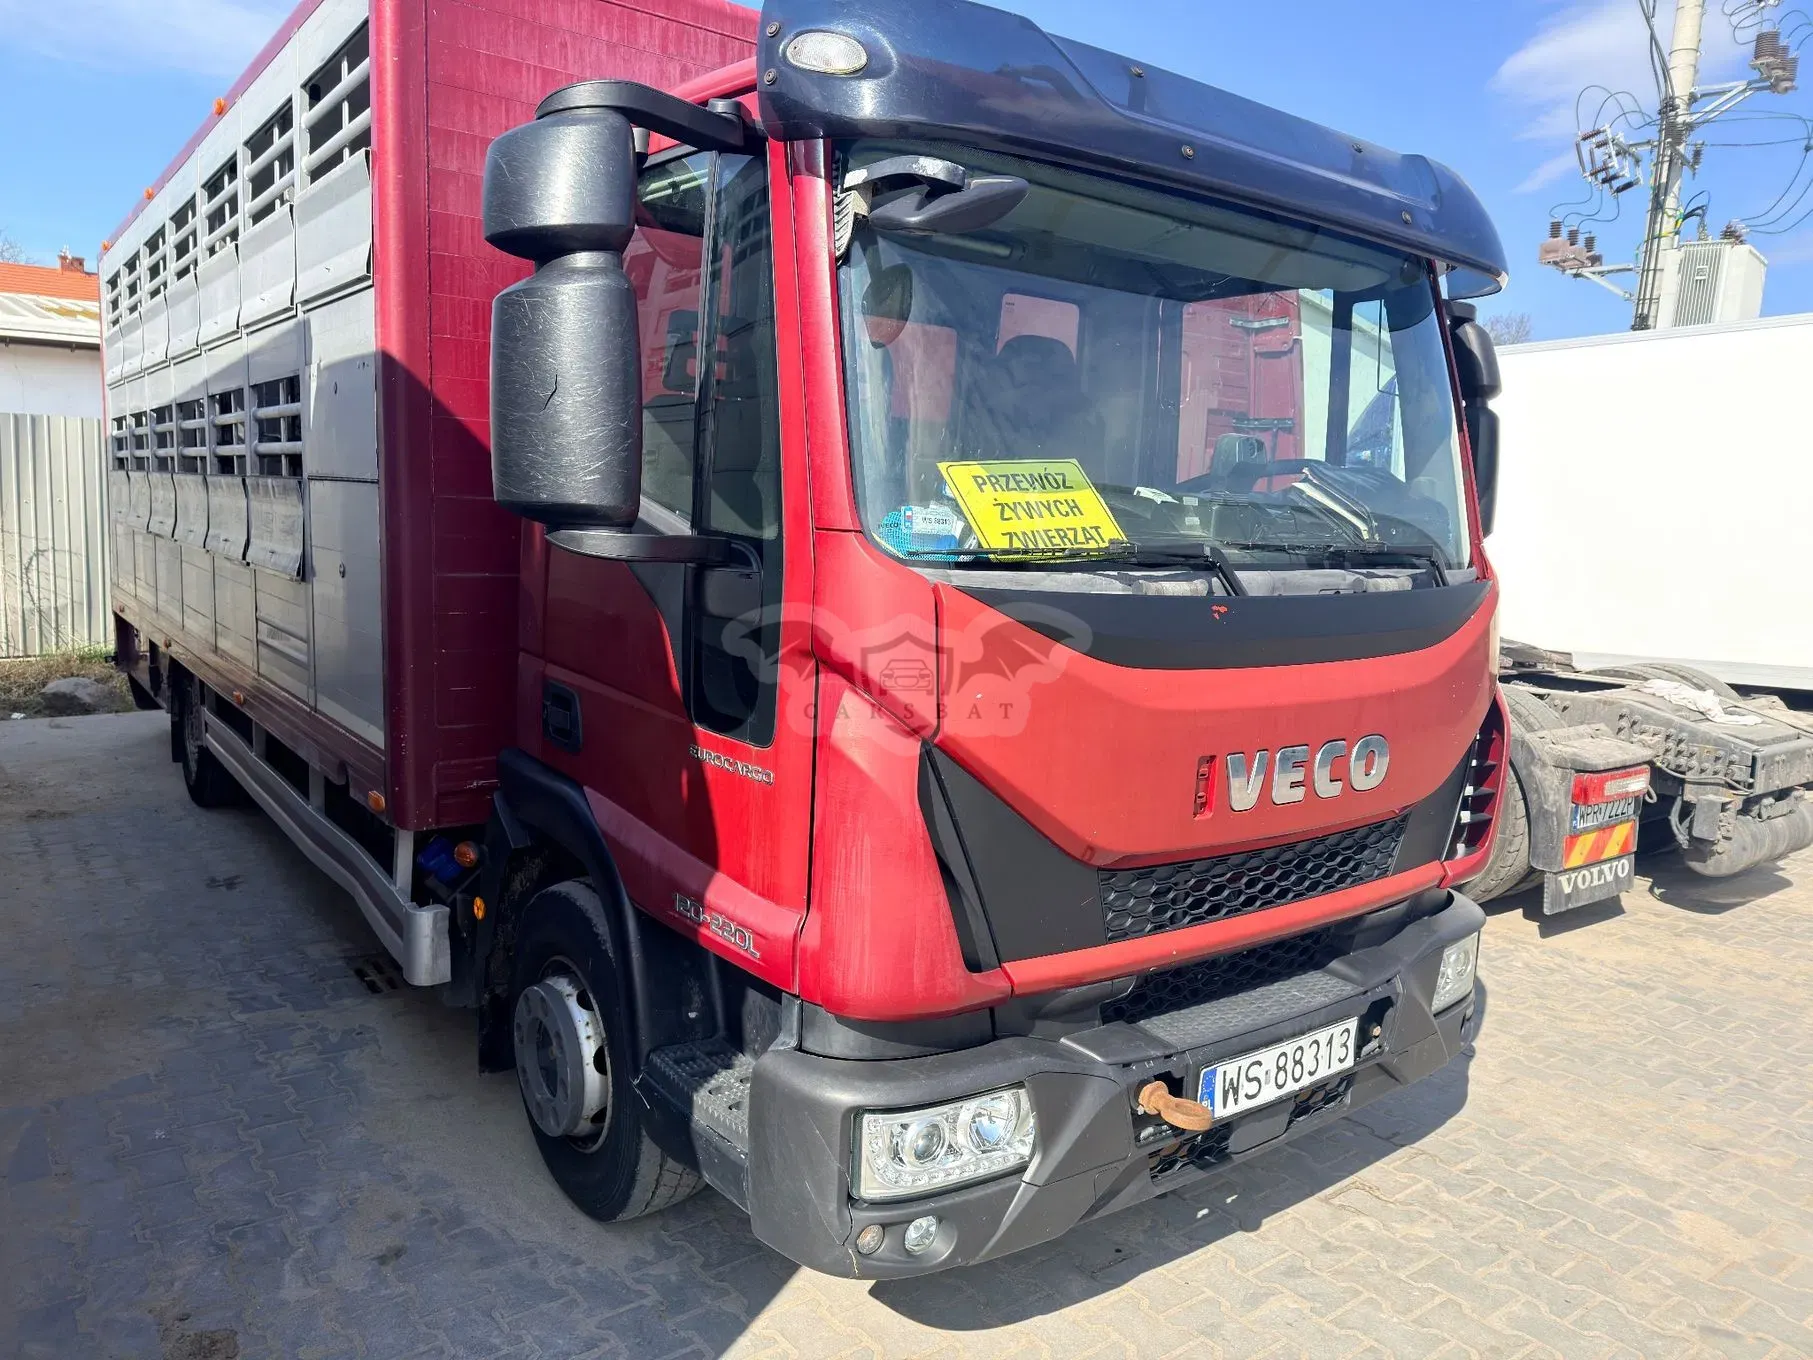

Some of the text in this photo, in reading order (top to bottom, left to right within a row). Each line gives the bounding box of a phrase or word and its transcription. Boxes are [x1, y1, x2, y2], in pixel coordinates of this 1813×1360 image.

[971, 466, 1074, 493] PRZEWÓZ
[992, 497, 1085, 521] ŻYWYCH
[688, 744, 775, 786] EUROCARGO
[1558, 858, 1630, 895] VOLVO
[1221, 1027, 1351, 1110] WS 88313
